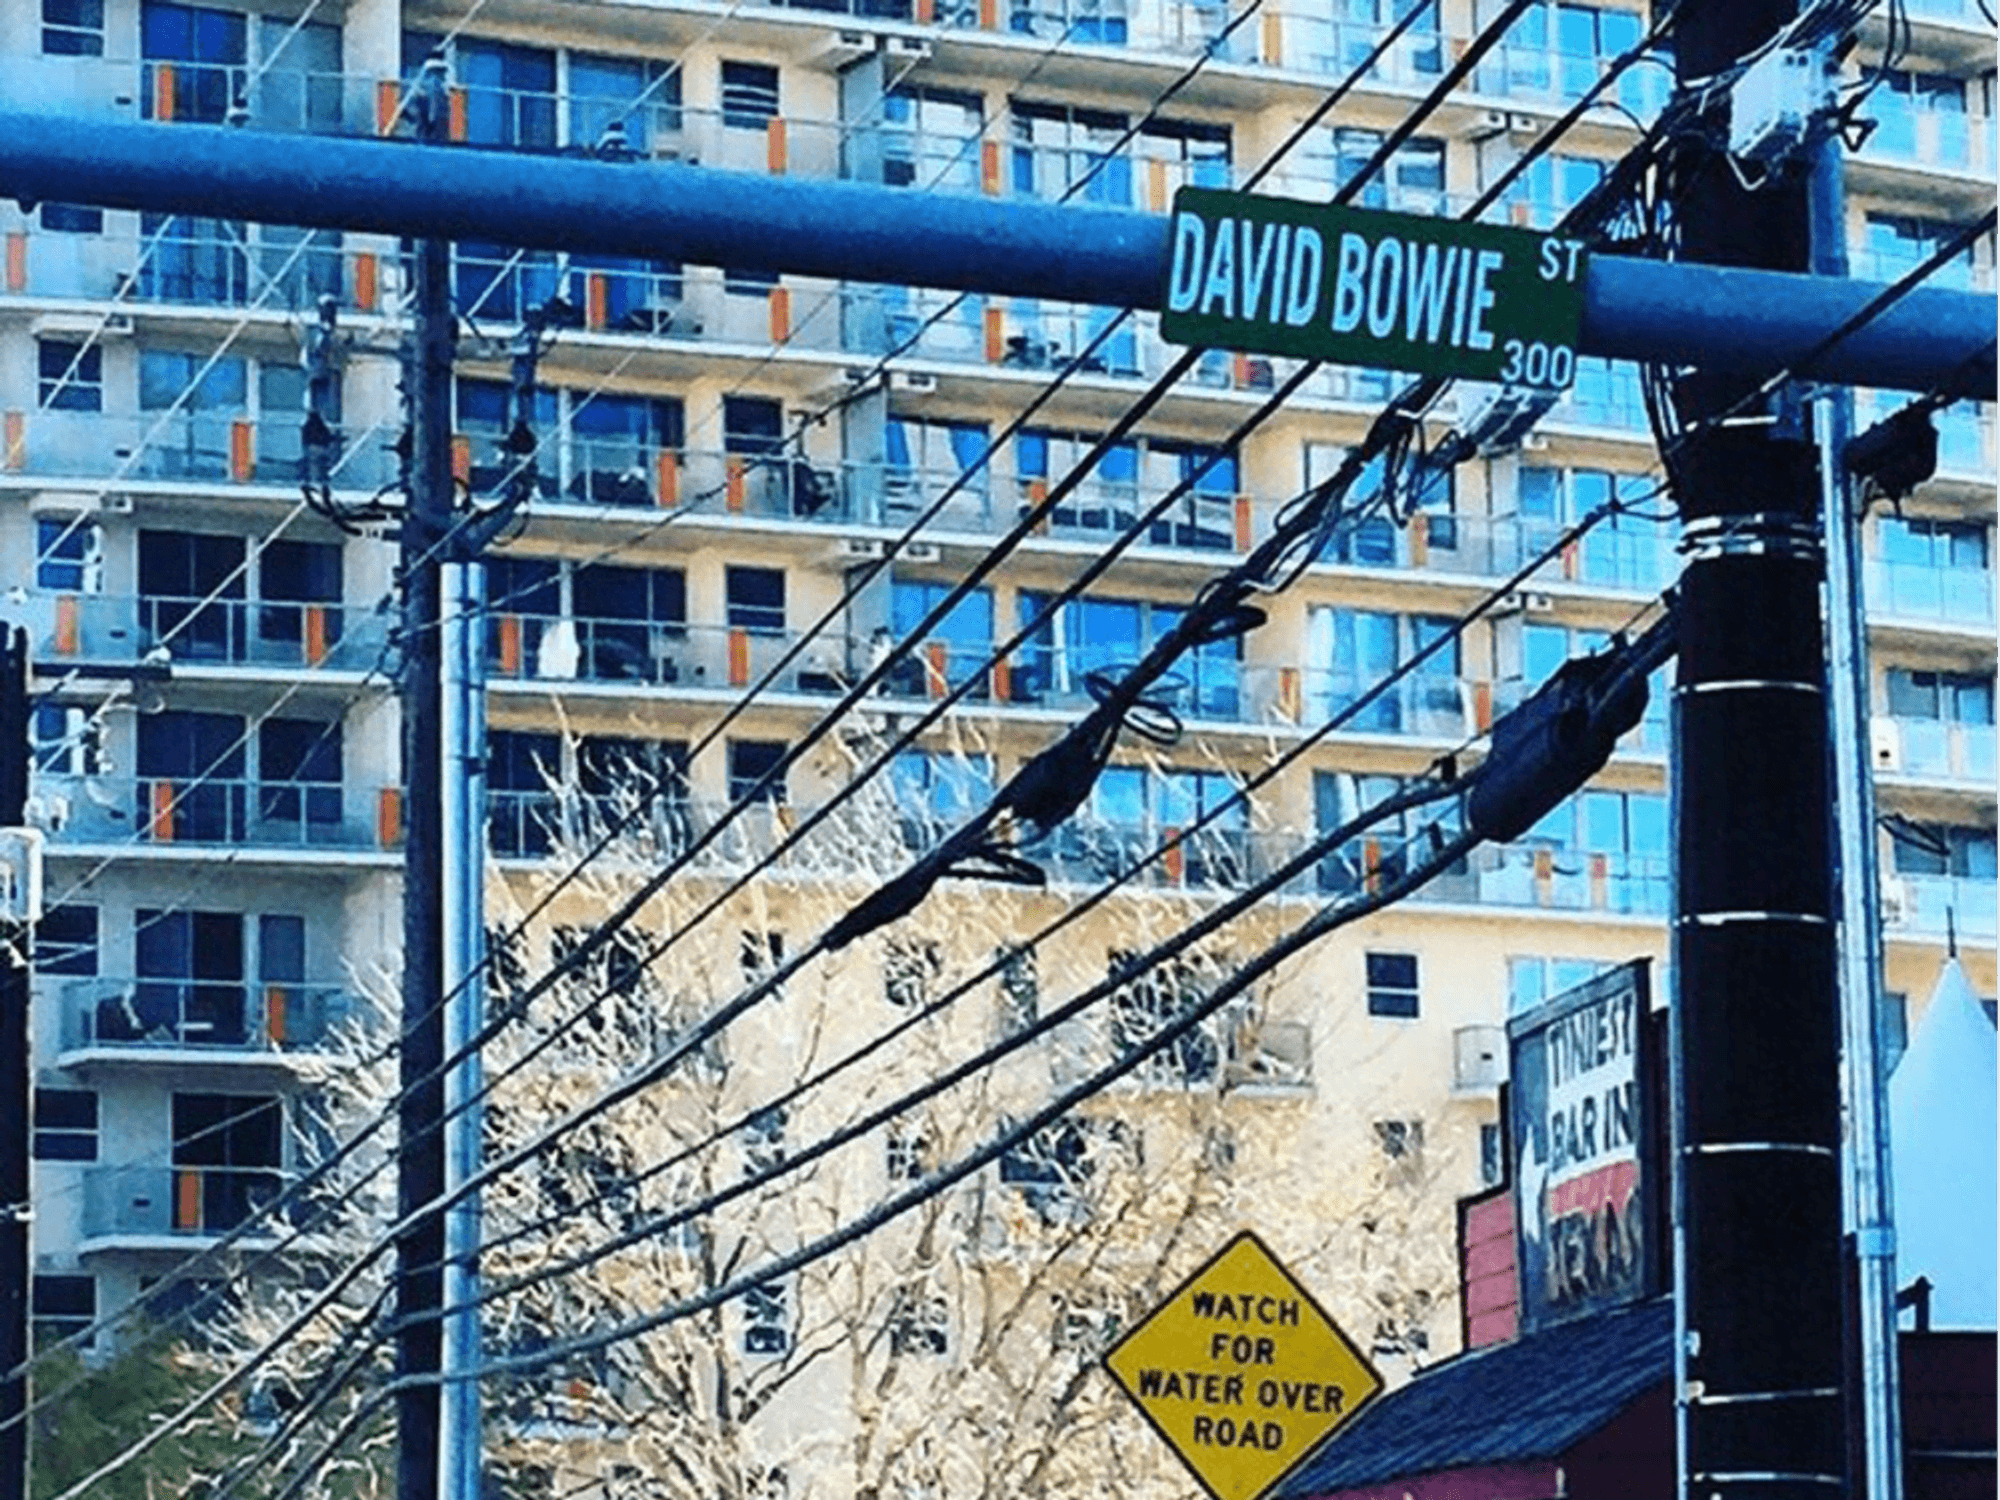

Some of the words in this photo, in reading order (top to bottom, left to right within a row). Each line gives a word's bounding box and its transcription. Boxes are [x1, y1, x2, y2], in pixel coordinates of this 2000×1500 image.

[1168, 211, 1323, 326] DAVID
[1331, 232, 1503, 351] BOWIE
[1539, 236, 1585, 283] ST
[1501, 339, 1574, 387] 300
[1549, 992, 1634, 1089] TINIEST
[1551, 1095, 1597, 1174] BAR
[1604, 1080, 1635, 1152] IN
[1192, 1291, 1299, 1327] WATCH
[1211, 1332, 1275, 1365] FOR
[1138, 1369, 1244, 1406] WATER
[1257, 1379, 1345, 1415] OVER
[1193, 1415, 1284, 1451] ROAD
